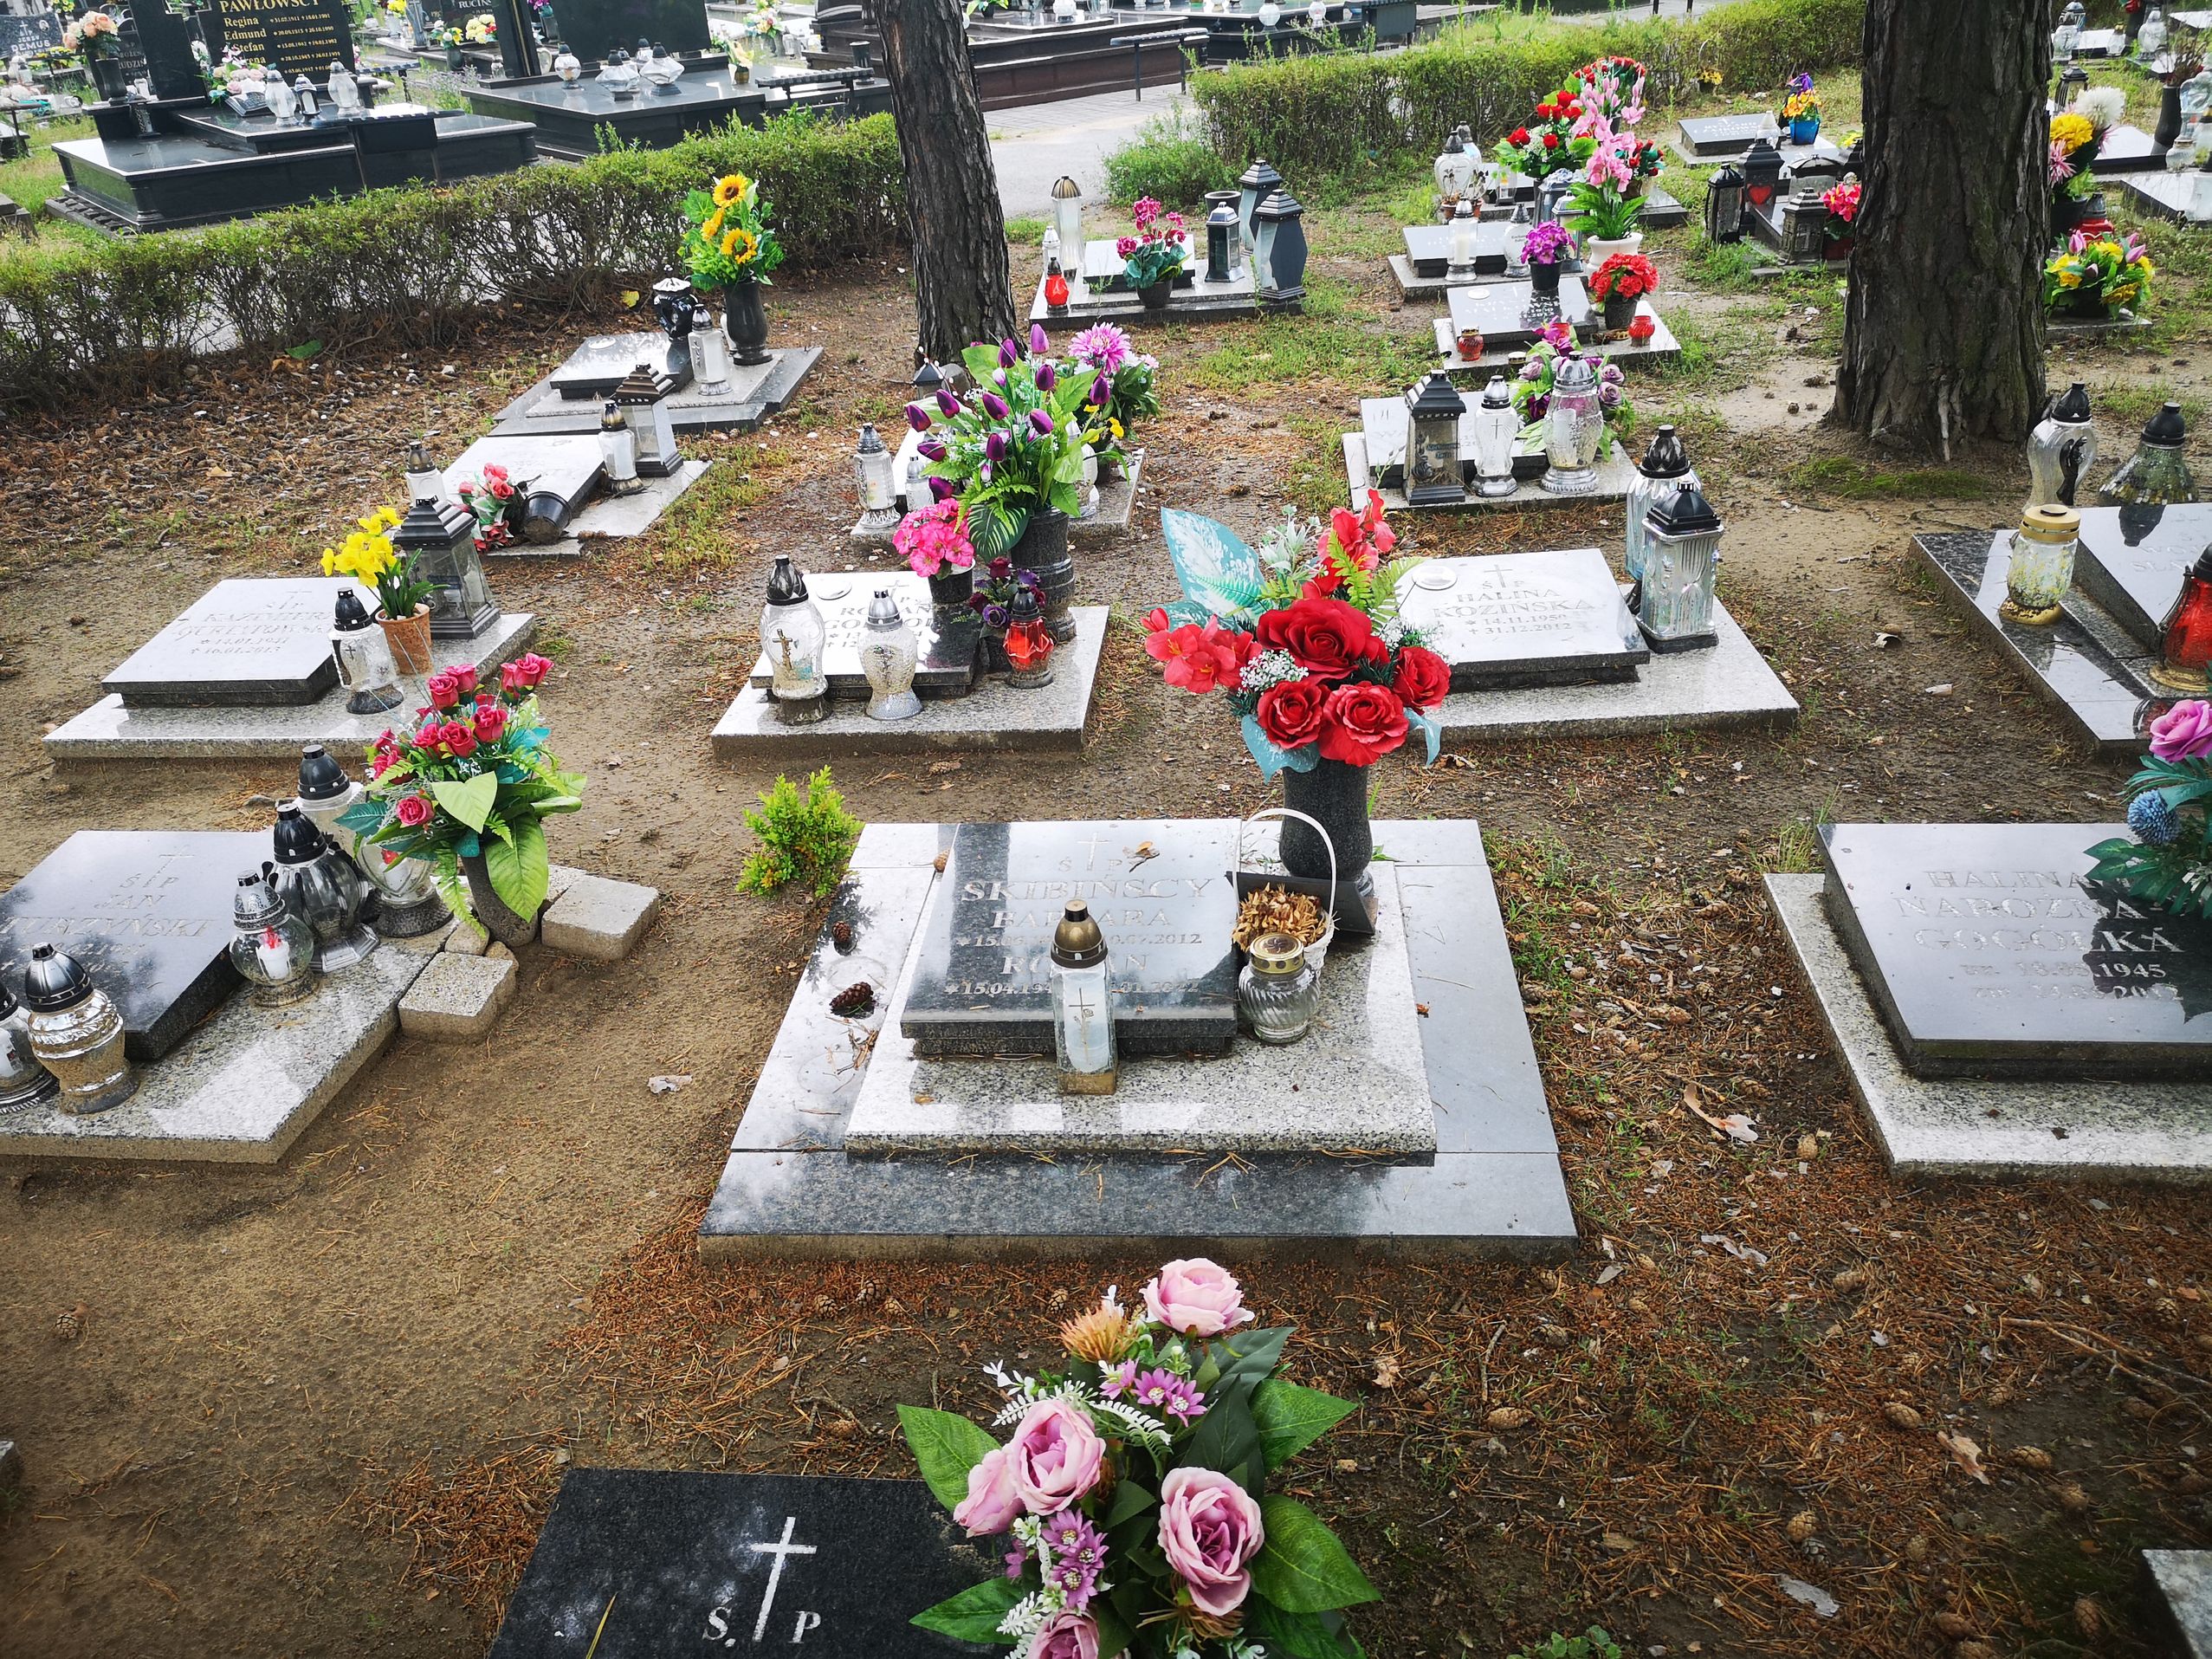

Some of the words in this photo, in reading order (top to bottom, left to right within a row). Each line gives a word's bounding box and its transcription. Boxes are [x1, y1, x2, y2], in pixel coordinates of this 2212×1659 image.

[223, 16, 260, 28] Regina
[223, 29, 267, 41] Edmund
[10, 40, 50, 52] DEMUS
[233, 42, 265, 52] Stefan
[1457, 589, 1562, 603] HALINA
[838, 599, 933, 618] ROAN
[960, 875, 1214, 902] SKIBIŃSCY
[94, 895, 167, 910] JAN
[991, 908, 1171, 929] BARARA
[787, 1610, 821, 1644] P
